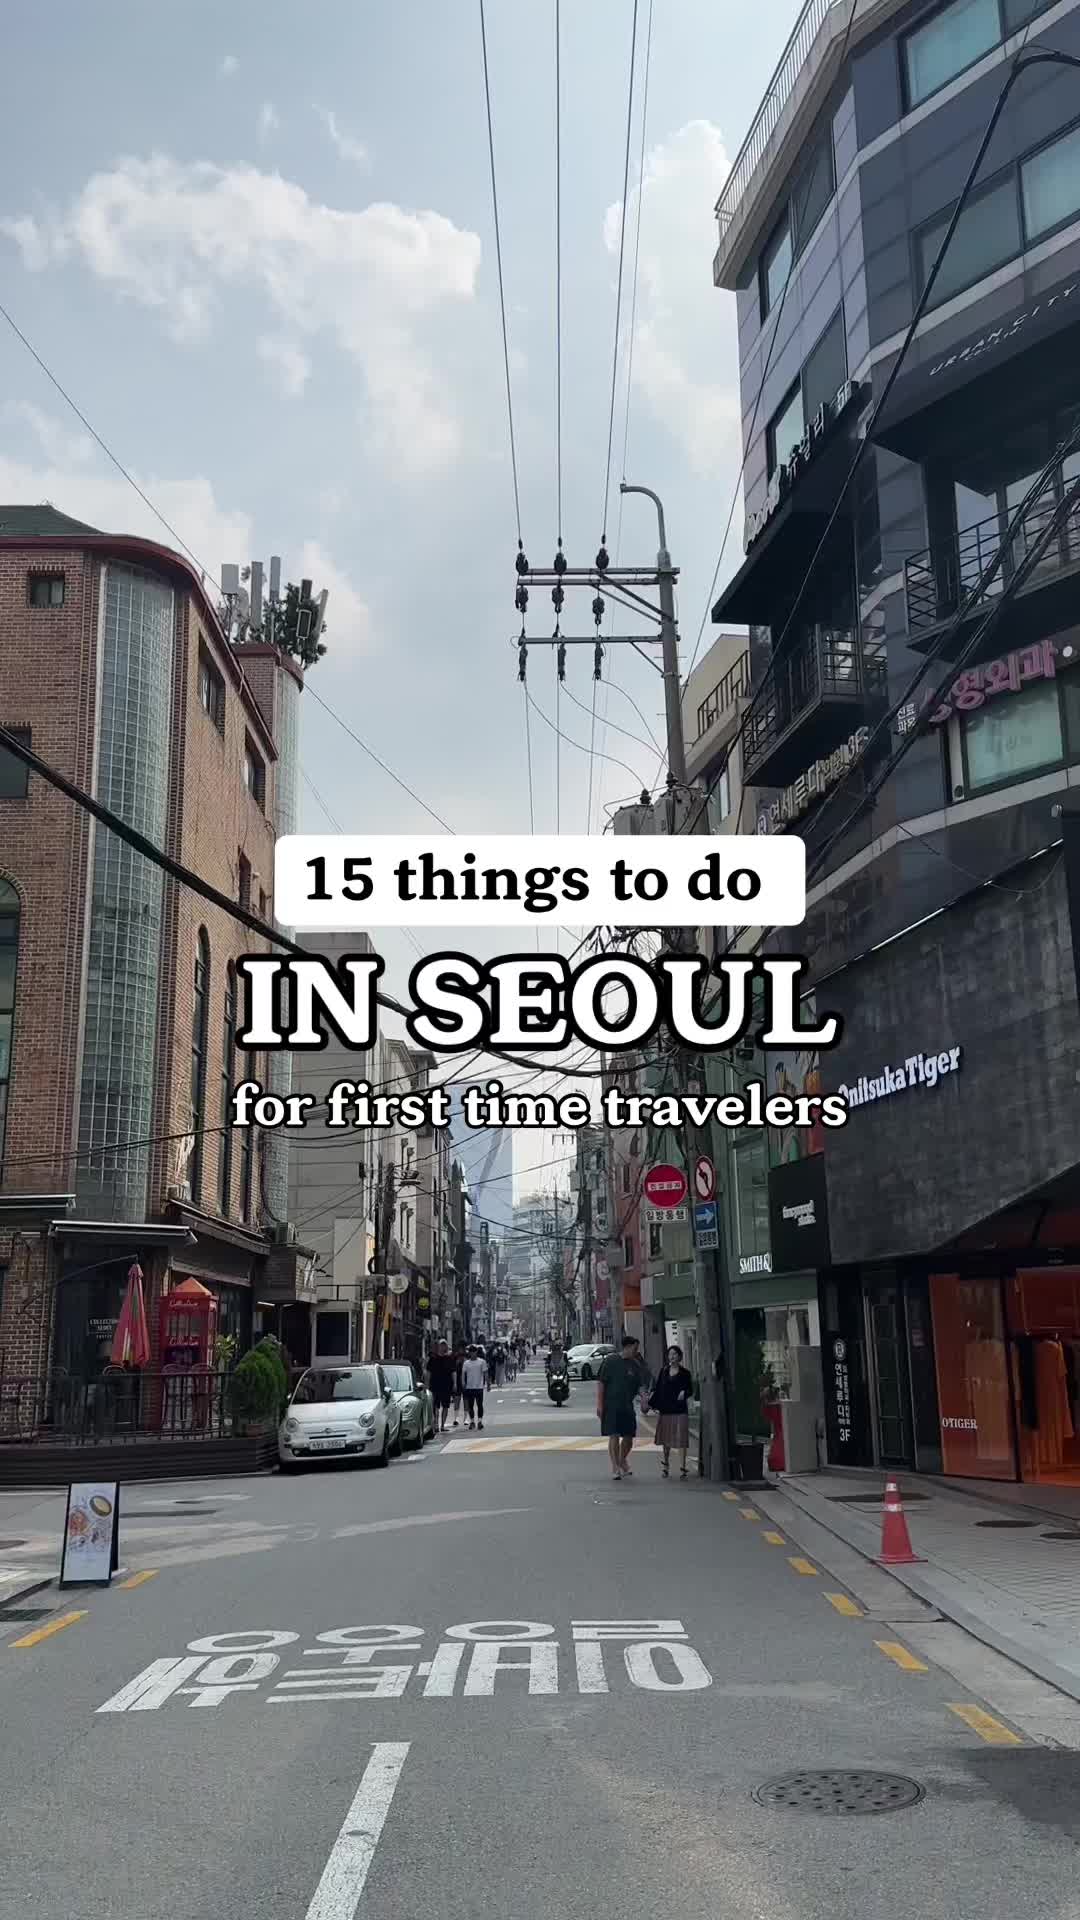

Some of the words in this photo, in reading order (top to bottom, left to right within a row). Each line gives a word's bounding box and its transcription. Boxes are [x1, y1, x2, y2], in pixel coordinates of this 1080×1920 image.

[646, 1209, 684, 1221] 일방통행
[839, 1427, 851, 1442] 3F
[95, 1619, 713, 1713] 일방통행
